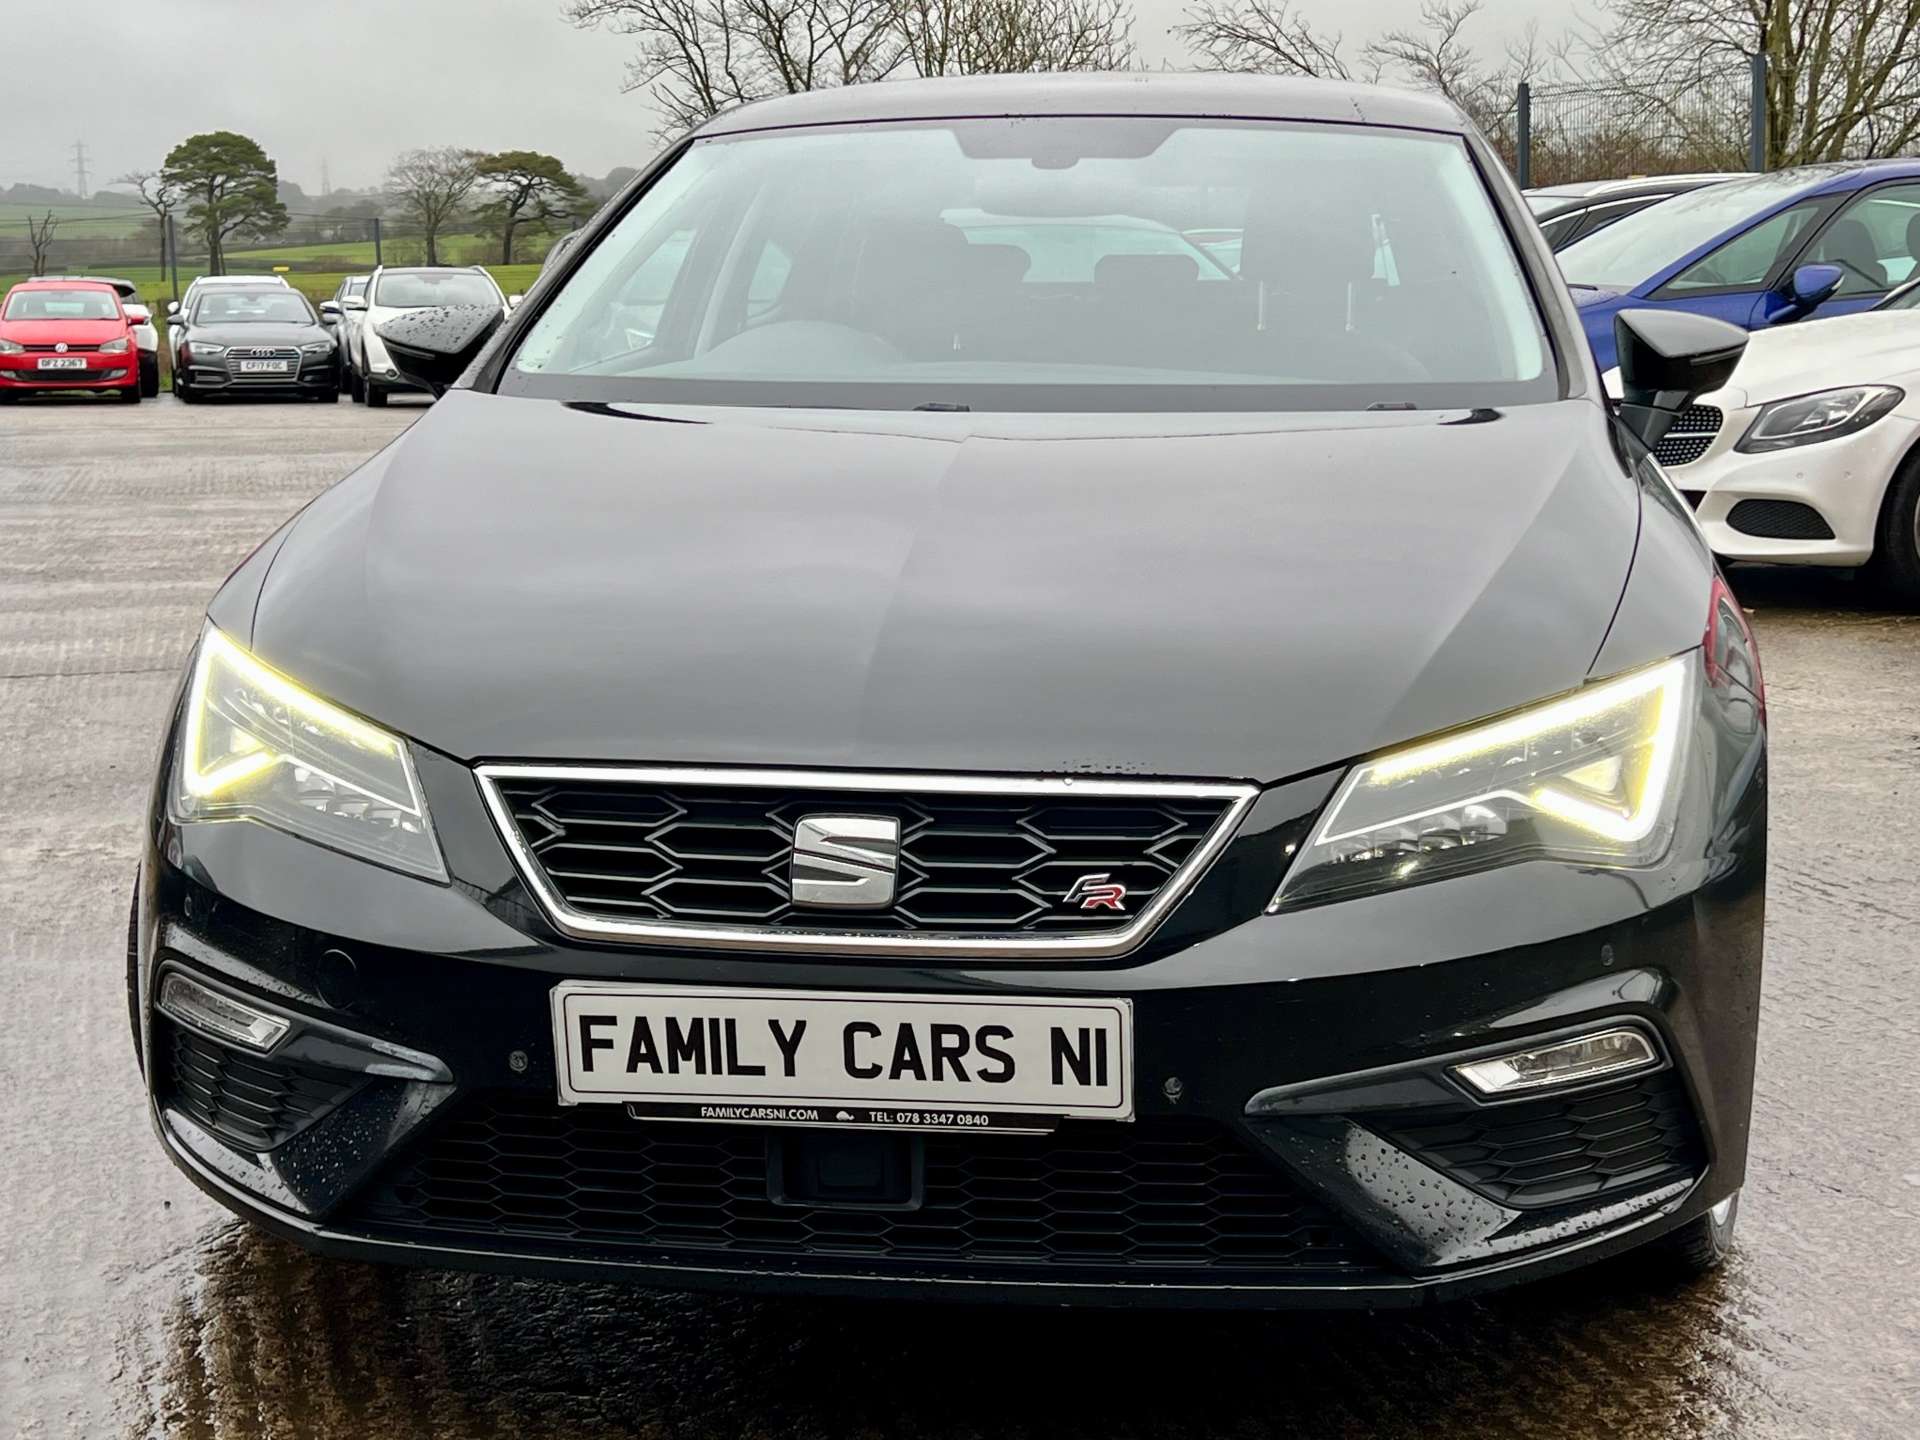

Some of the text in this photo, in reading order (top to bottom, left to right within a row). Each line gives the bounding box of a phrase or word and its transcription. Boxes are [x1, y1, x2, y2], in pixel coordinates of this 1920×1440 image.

[1063, 873, 1126, 910] FR
[579, 1015, 1108, 1086] FAMILY CARS NI
[701, 1106, 989, 1126] FAMILYCARSNI.COM TEL: 078 3347 0840
